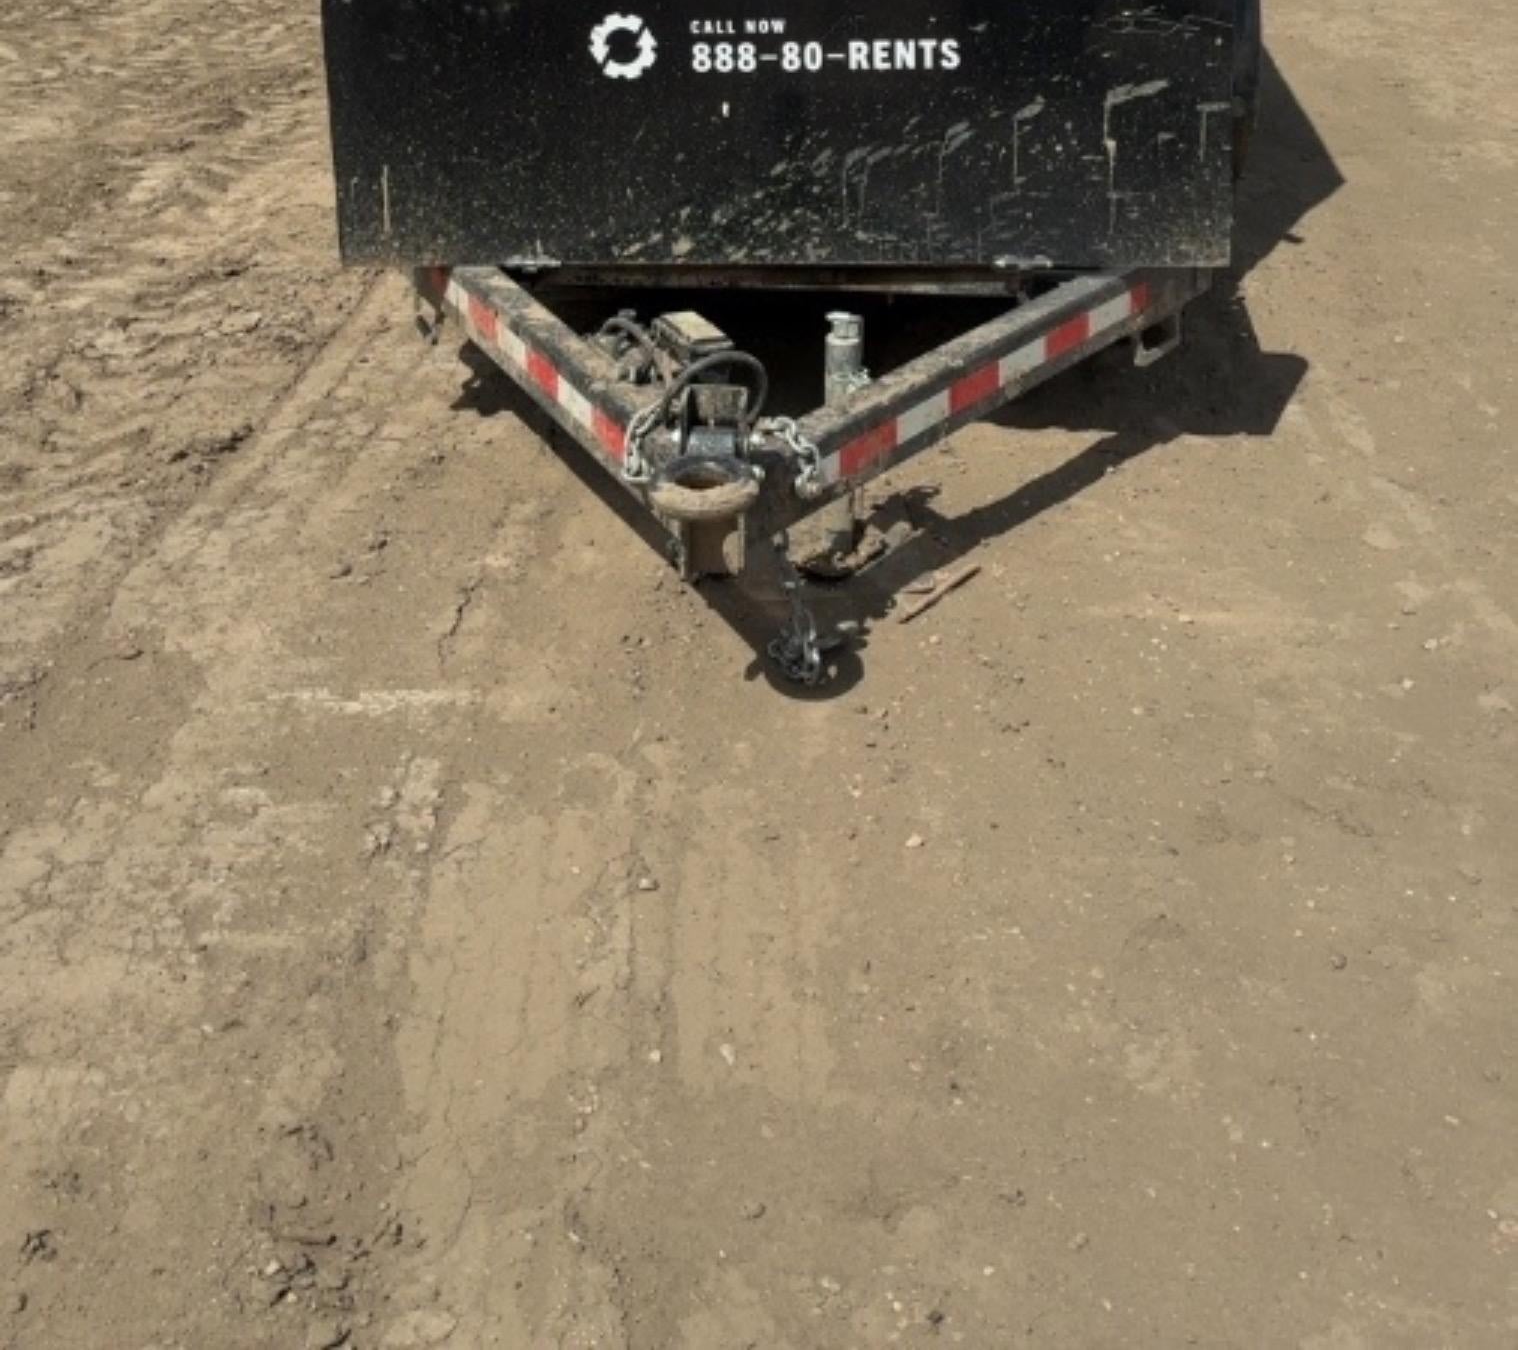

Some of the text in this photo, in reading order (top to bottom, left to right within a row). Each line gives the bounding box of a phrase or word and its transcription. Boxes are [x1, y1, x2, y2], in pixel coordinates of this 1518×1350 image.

[689, 19, 786, 34] CALL NOW
[691, 39, 962, 73] 888-80-RENTS
